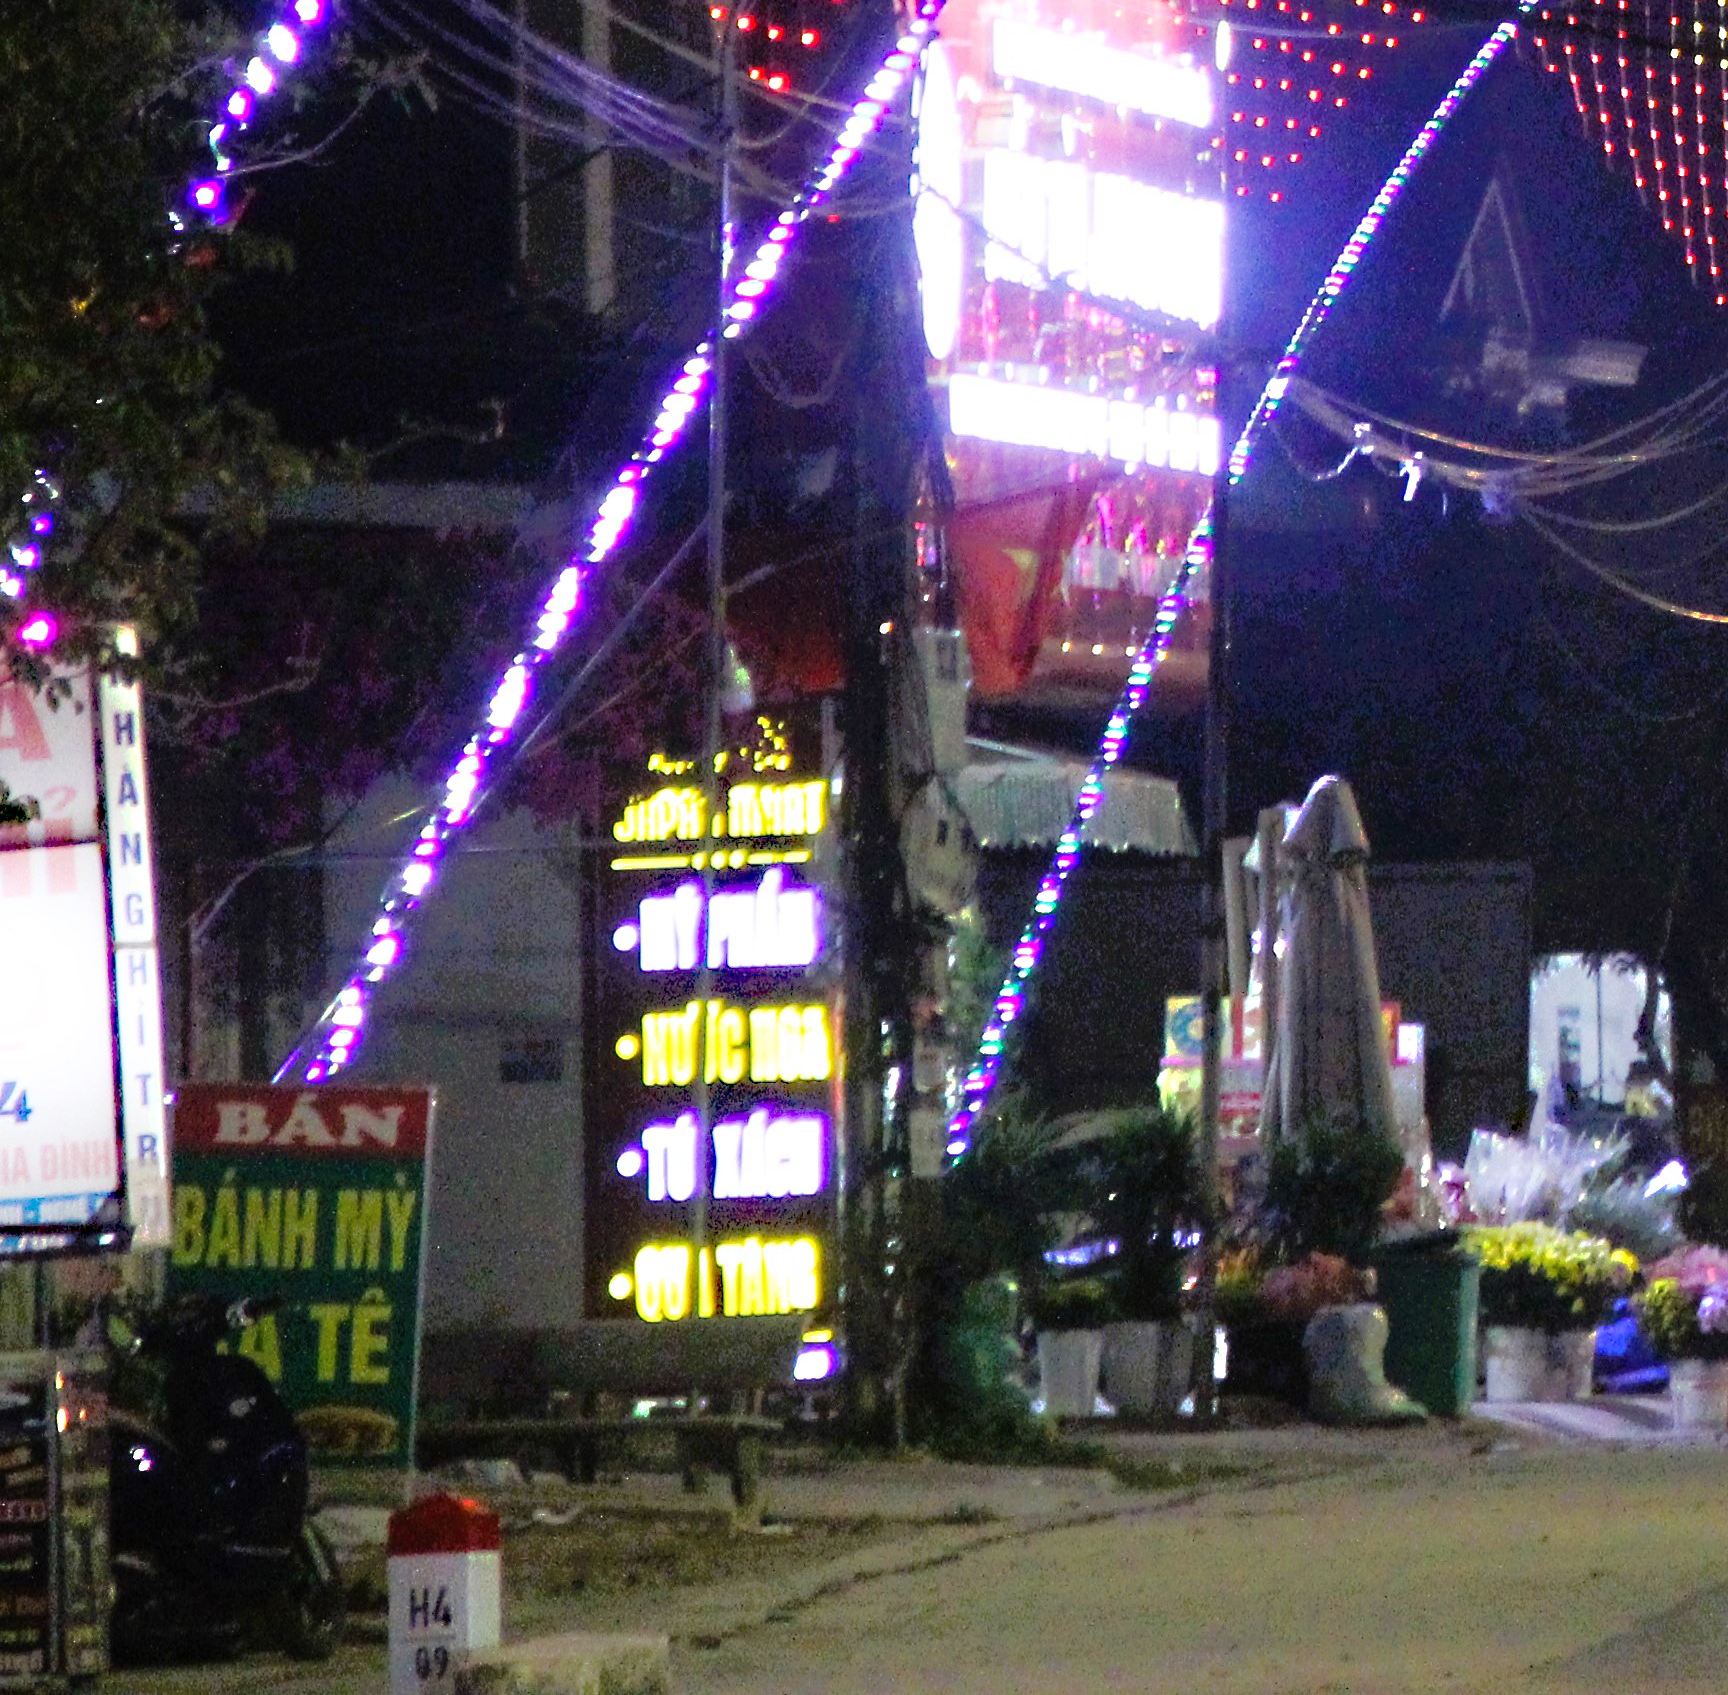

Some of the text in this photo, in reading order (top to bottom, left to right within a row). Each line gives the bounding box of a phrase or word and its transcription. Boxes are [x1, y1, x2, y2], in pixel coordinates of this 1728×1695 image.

[213, 1092, 405, 1147] BÁN
[171, 1166, 320, 1269] BÁNH
[409, 1585, 452, 1629] H4
